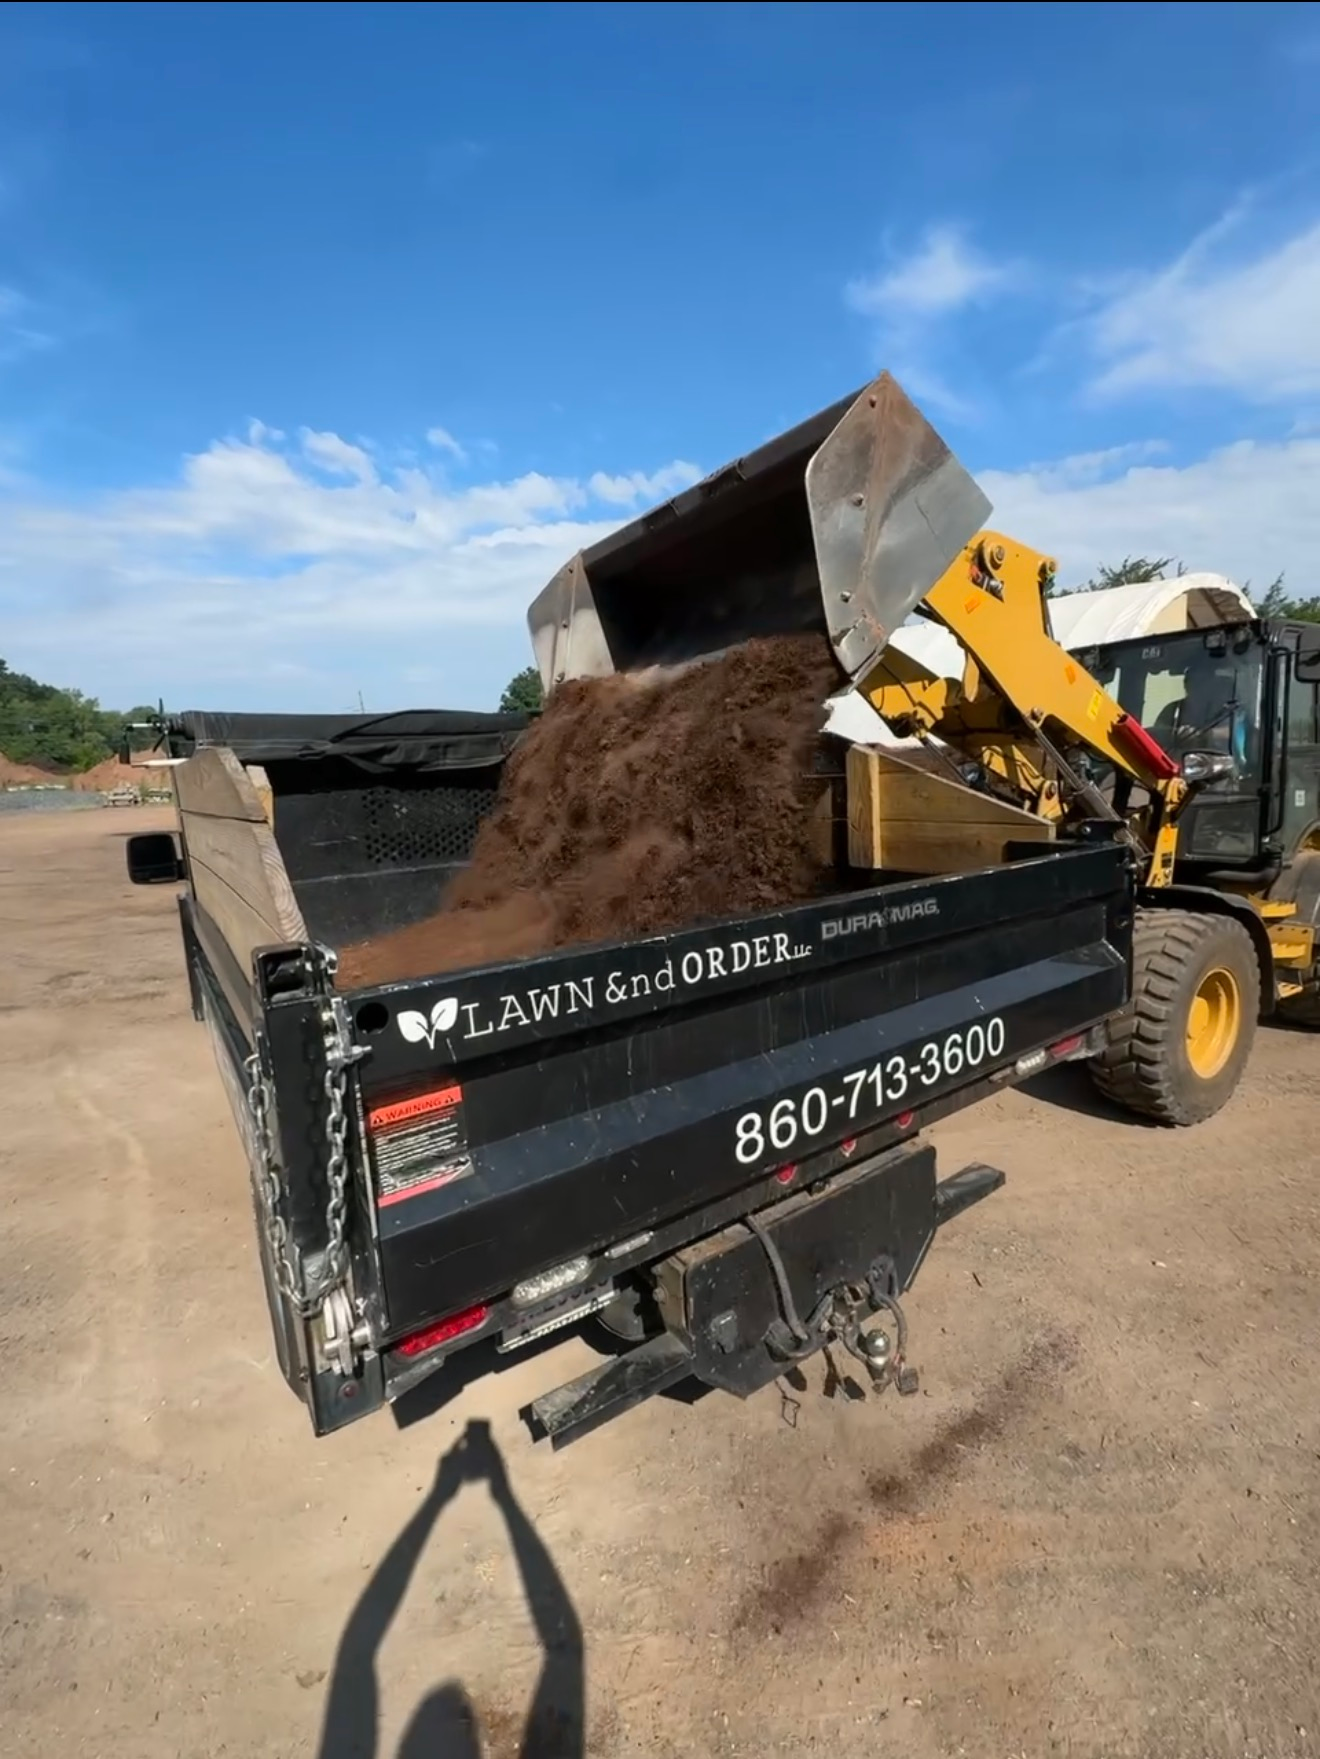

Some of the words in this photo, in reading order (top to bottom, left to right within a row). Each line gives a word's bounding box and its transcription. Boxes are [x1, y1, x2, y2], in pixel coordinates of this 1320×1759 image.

[460, 976, 594, 1039] LAWN
[605, 959, 677, 1004] &nd
[681, 932, 792, 984] ORDER
[734, 1017, 1005, 1164] 860-713-3600
